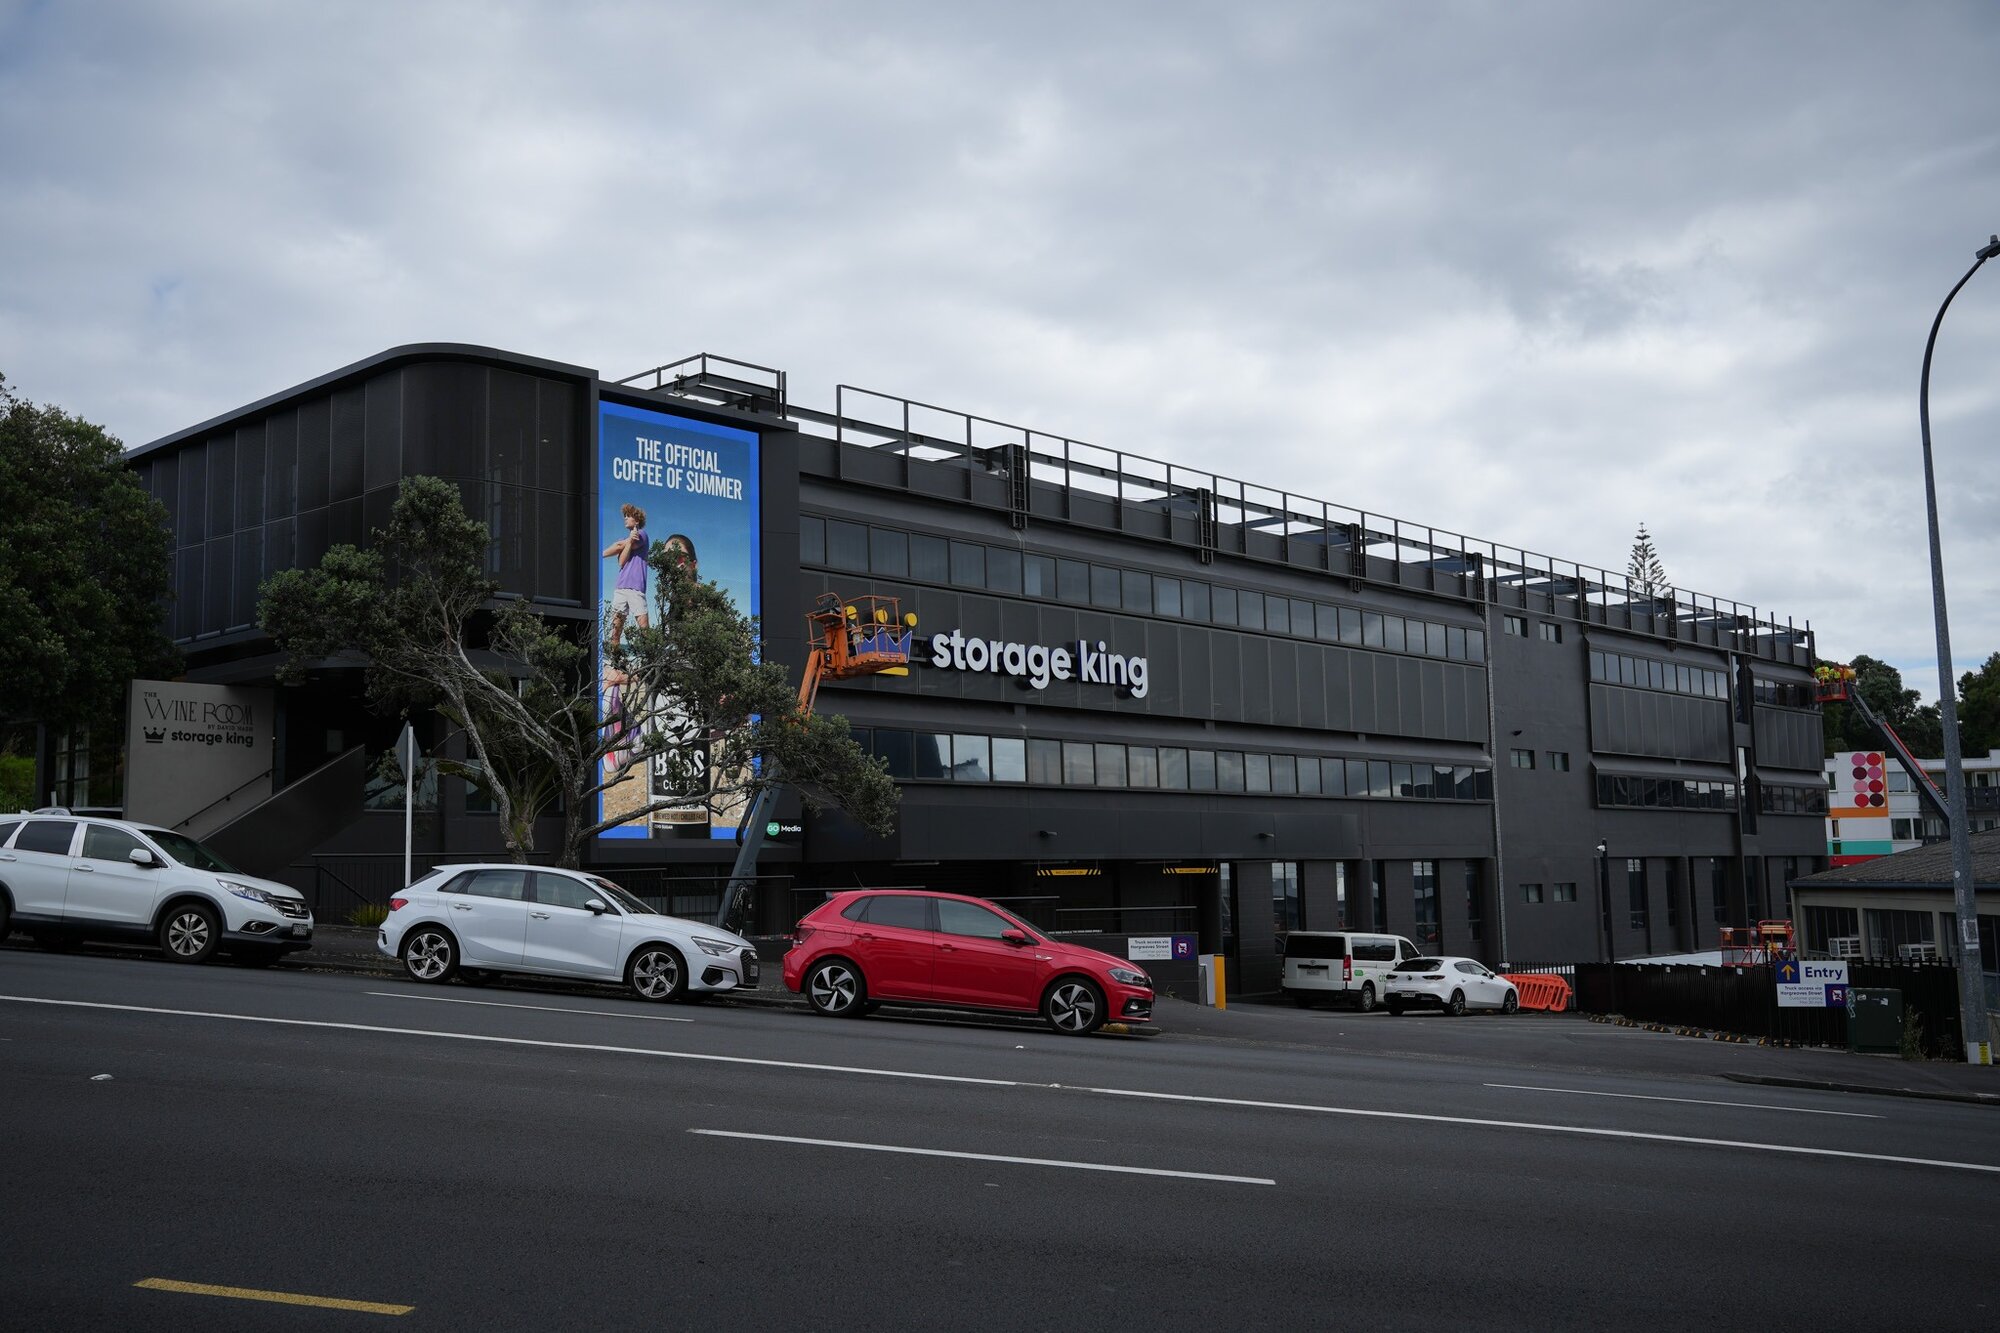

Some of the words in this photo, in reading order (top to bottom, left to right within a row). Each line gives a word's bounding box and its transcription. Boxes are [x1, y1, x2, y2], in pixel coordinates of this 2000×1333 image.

[636, 437, 661, 462] THE
[665, 443, 721, 474] OFFICIAL
[613, 457, 663, 487] COFFEE
[666, 467, 684, 490] OF
[686, 470, 742, 500] SUMMER
[932, 629, 1072, 690] storage
[1078, 640, 1149, 699] king
[144, 698, 198, 722] WINE
[203, 702, 254, 725] ROOM
[171, 730, 223, 746] storage
[226, 732, 254, 748] king
[663, 779, 699, 791] COFE
[1805, 966, 1843, 981] Entry
